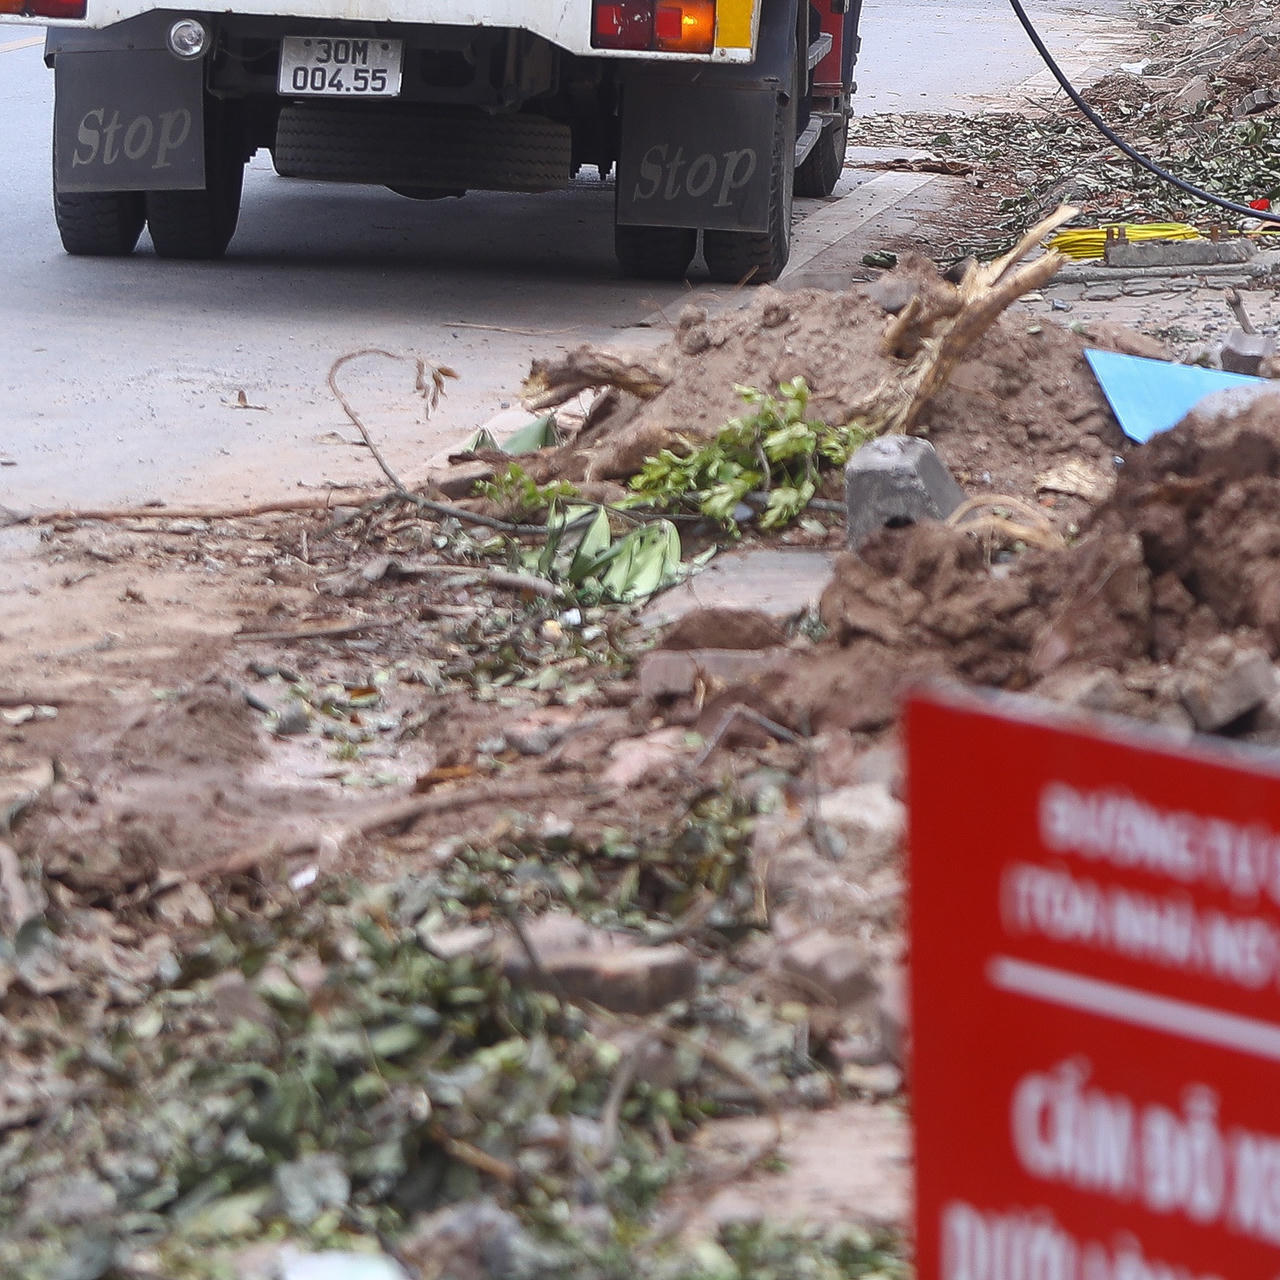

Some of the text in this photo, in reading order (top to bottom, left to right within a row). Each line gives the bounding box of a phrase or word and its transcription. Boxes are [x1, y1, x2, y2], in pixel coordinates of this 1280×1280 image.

[314, 38, 369, 66] 30M
[292, 66, 388, 93] 004.55
[72, 107, 192, 169] Stop
[632, 144, 757, 207] Stop
